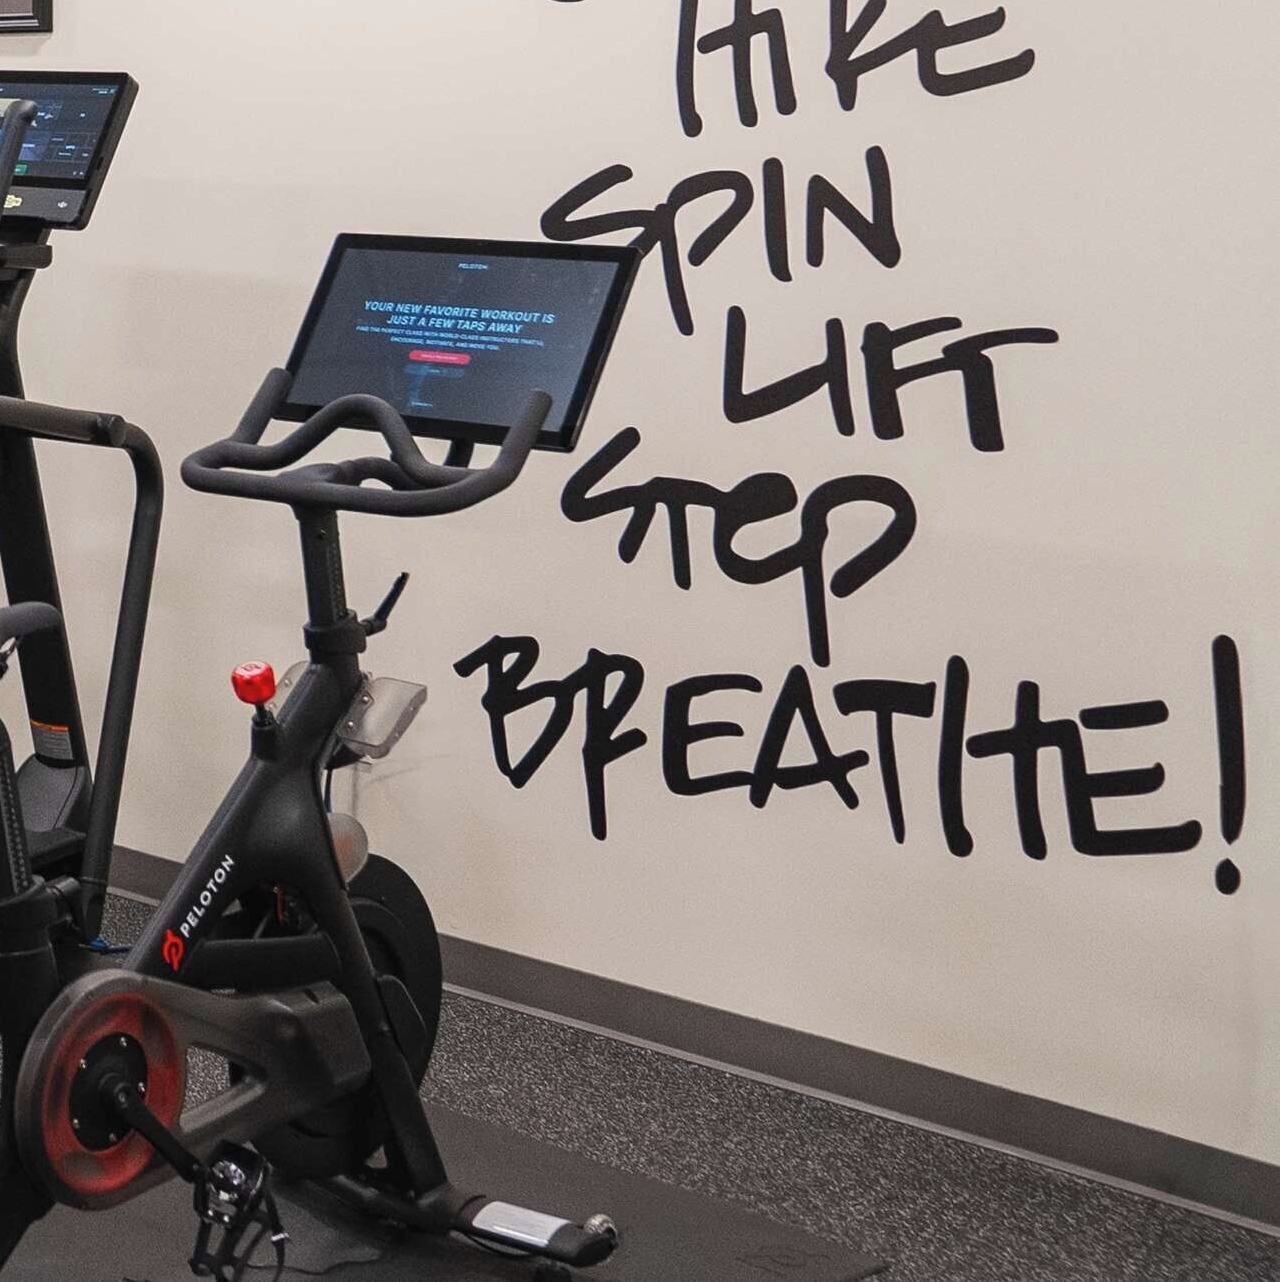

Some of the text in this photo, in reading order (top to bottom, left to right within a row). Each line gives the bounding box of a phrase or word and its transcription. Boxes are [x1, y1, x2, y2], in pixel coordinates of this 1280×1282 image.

[540, 145, 902, 336] SPIN
[365, 300, 556, 324] YOUR NEW FAVORITE WORKOUT IS
[386, 314, 524, 334] JUST A FEW TAPS AWAY
[724, 306, 1059, 453] LIFT
[452, 634, 1246, 895] BREATHE!
[179, 854, 235, 938] PELOTON
